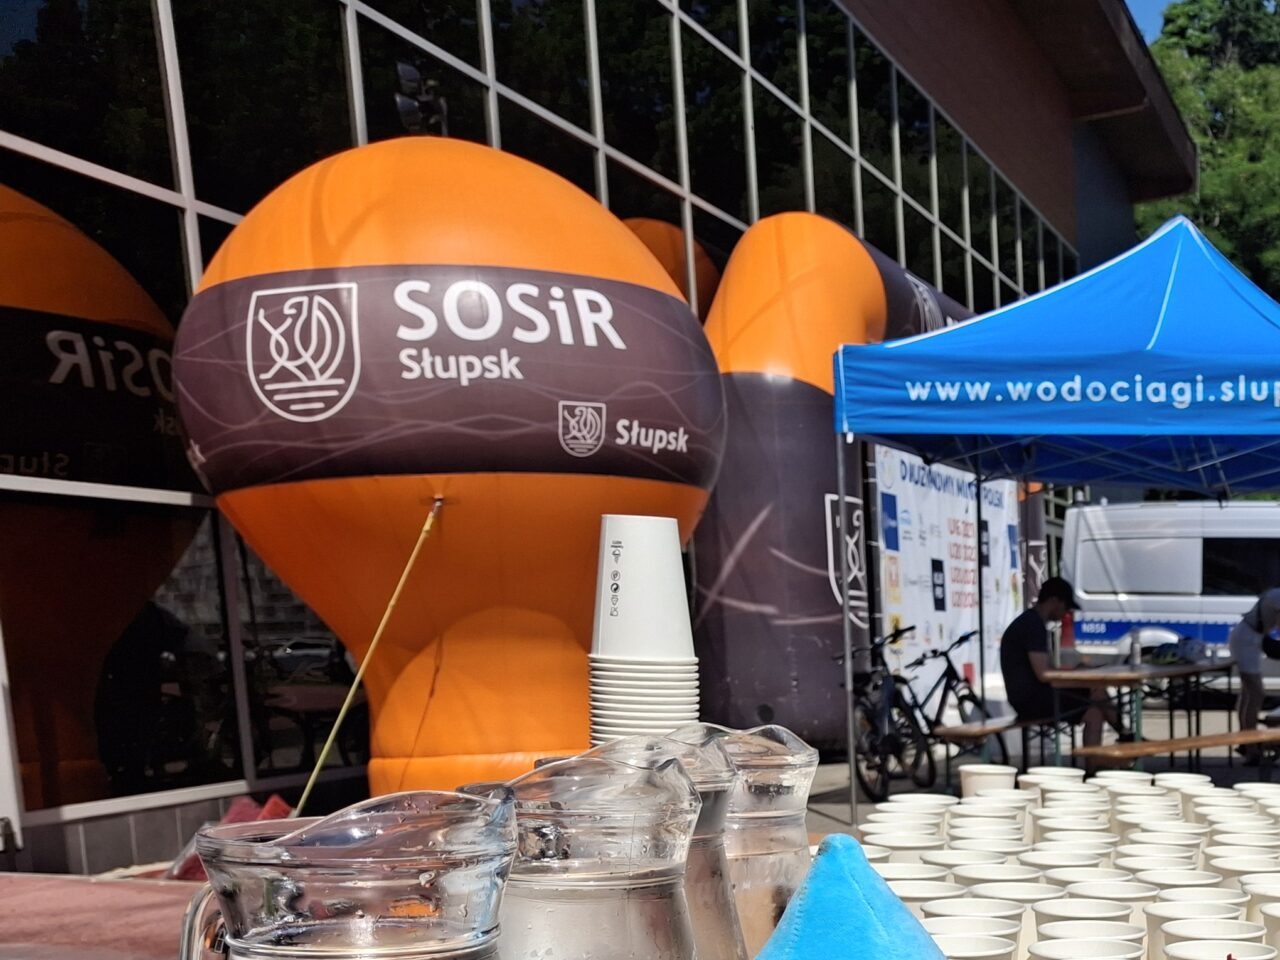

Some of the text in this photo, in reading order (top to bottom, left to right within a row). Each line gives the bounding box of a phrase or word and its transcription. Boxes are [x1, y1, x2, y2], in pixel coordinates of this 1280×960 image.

[394, 280, 627, 349] SOSiR
[399, 347, 524, 386] Słupsk
[615, 418, 689, 454] Słupsk
